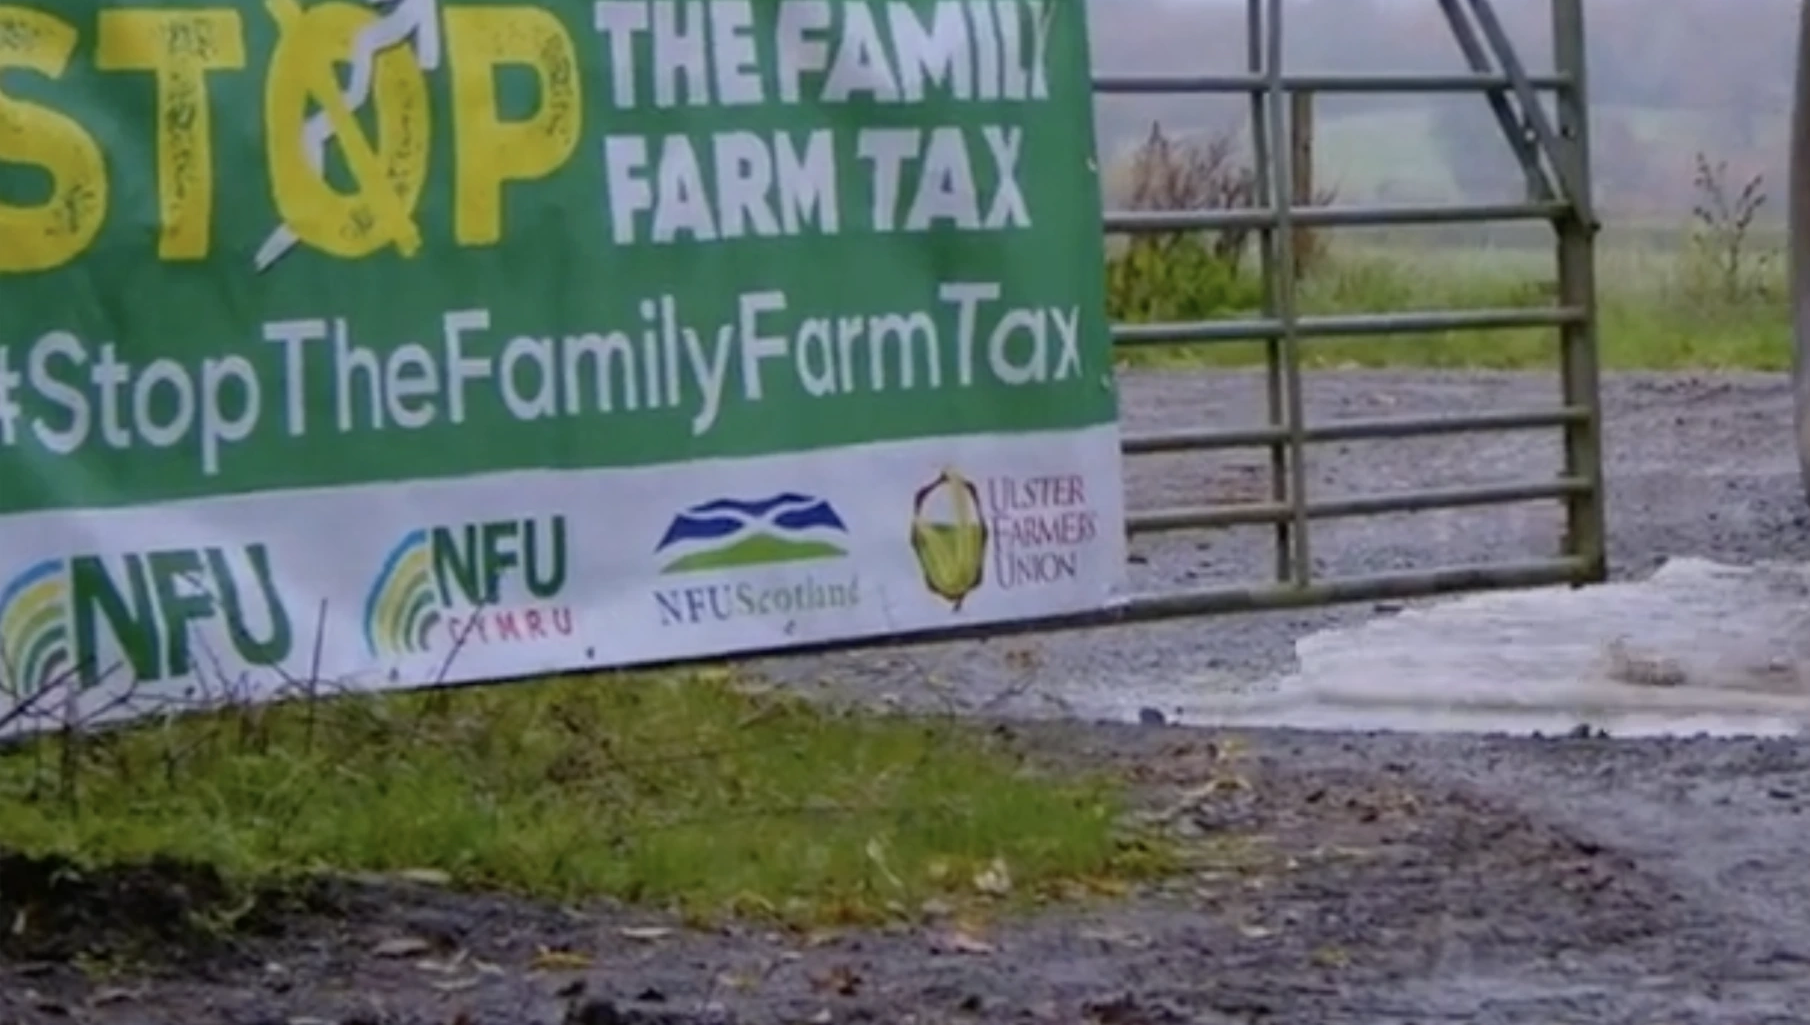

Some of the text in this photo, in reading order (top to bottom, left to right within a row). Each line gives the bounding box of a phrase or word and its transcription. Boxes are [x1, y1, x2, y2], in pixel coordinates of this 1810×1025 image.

[605, 125, 1032, 245] FARM TAX
[988, 475, 1086, 511] ULSTER
[432, 515, 566, 607] NFU
[994, 551, 1077, 591] UNION
[70, 543, 293, 687] NFU
[448, 606, 572, 647] CYMRU
